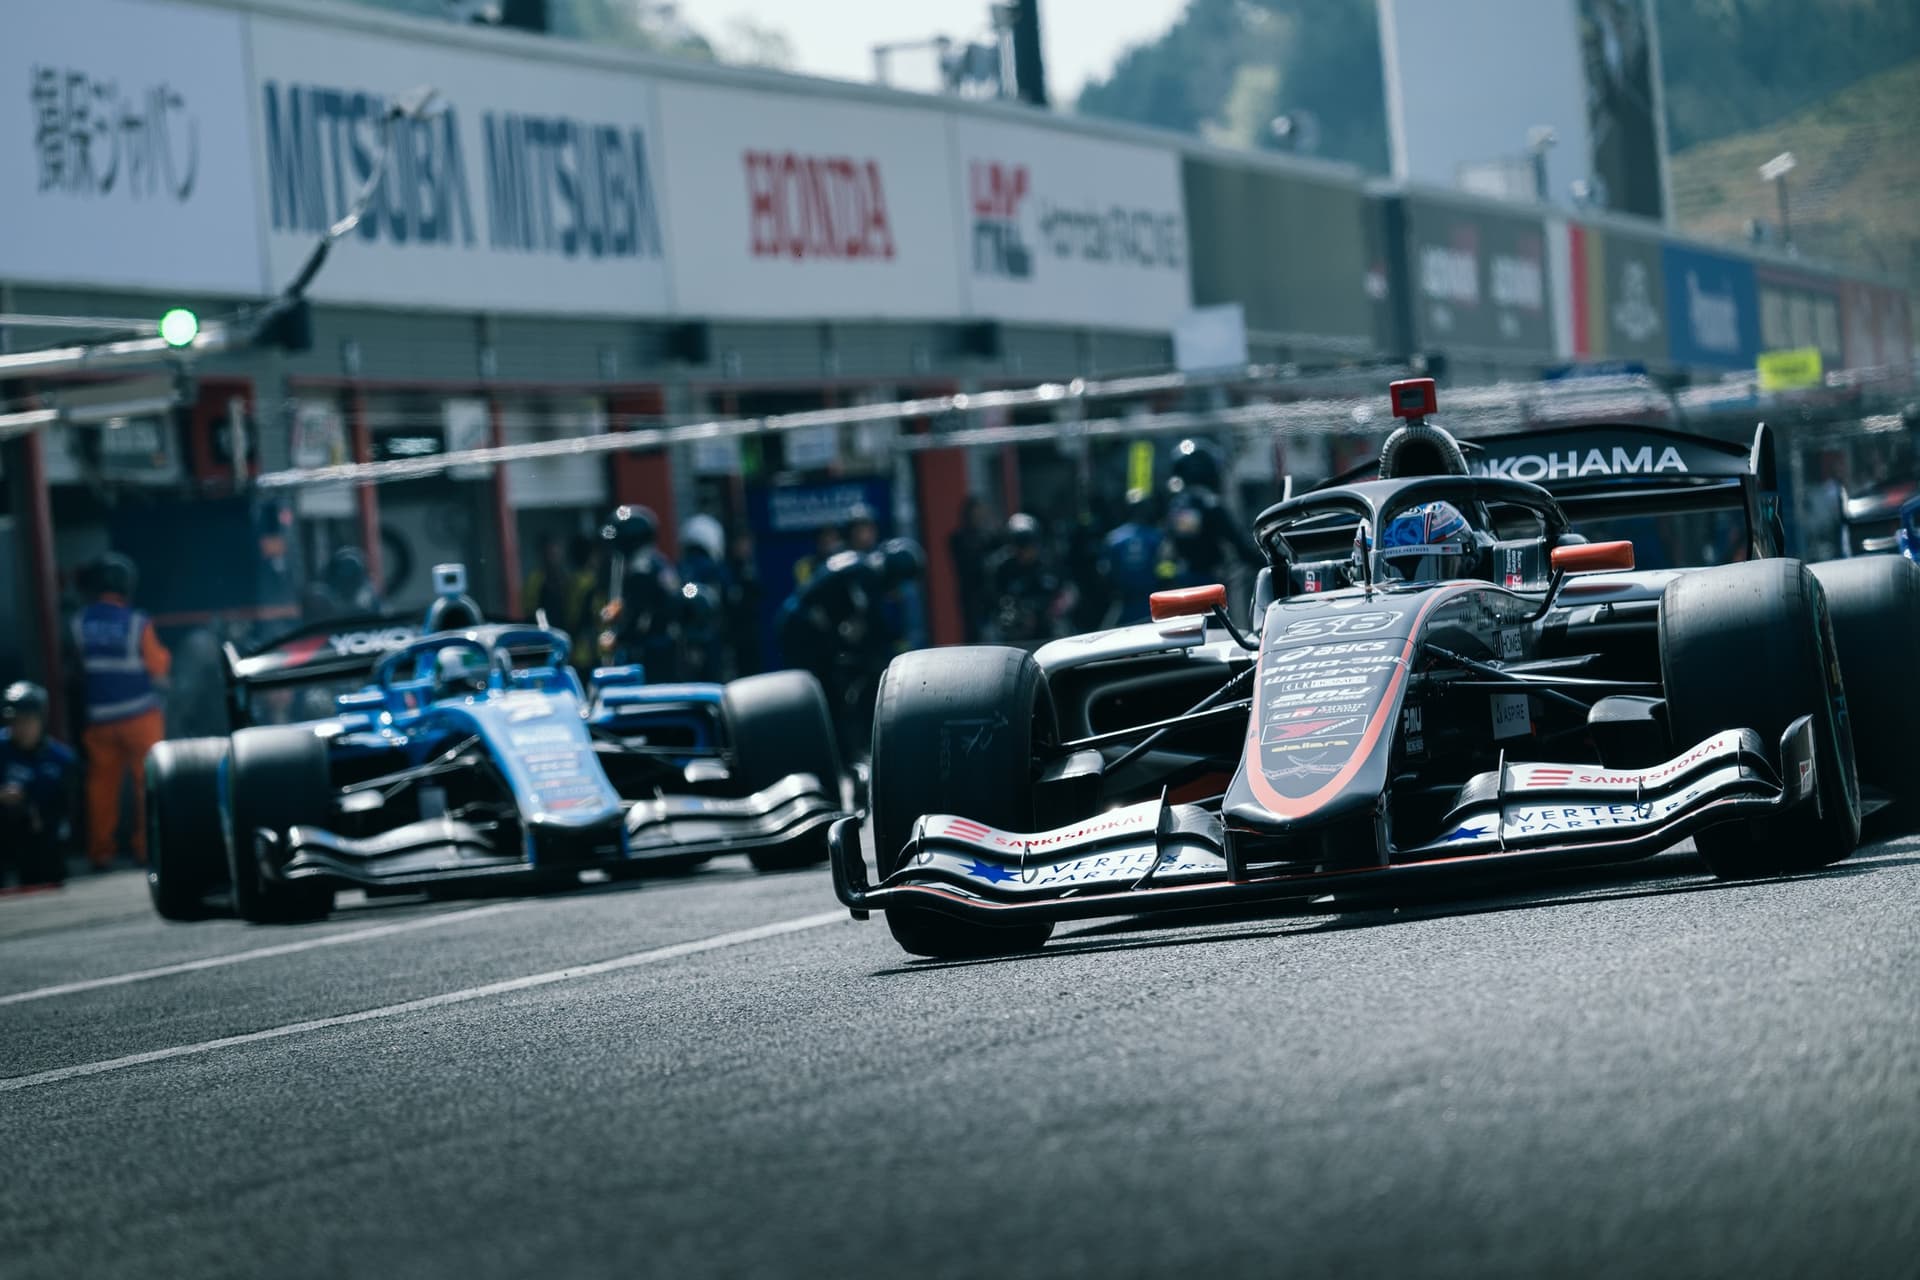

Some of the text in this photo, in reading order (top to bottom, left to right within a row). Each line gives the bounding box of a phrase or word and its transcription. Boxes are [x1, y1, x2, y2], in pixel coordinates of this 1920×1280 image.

[482, 108, 663, 260] MITSUBA
[743, 150, 896, 259] HONDA
[1479, 446, 1689, 481] KOHAMA
[1314, 641, 1389, 658] asics
[1579, 740, 1724, 784] SANKISHOKAI
[1514, 802, 1649, 823] VERTEX
[993, 815, 1144, 848] SANKISHOKAI
[1052, 852, 1181, 874] VERTEX
